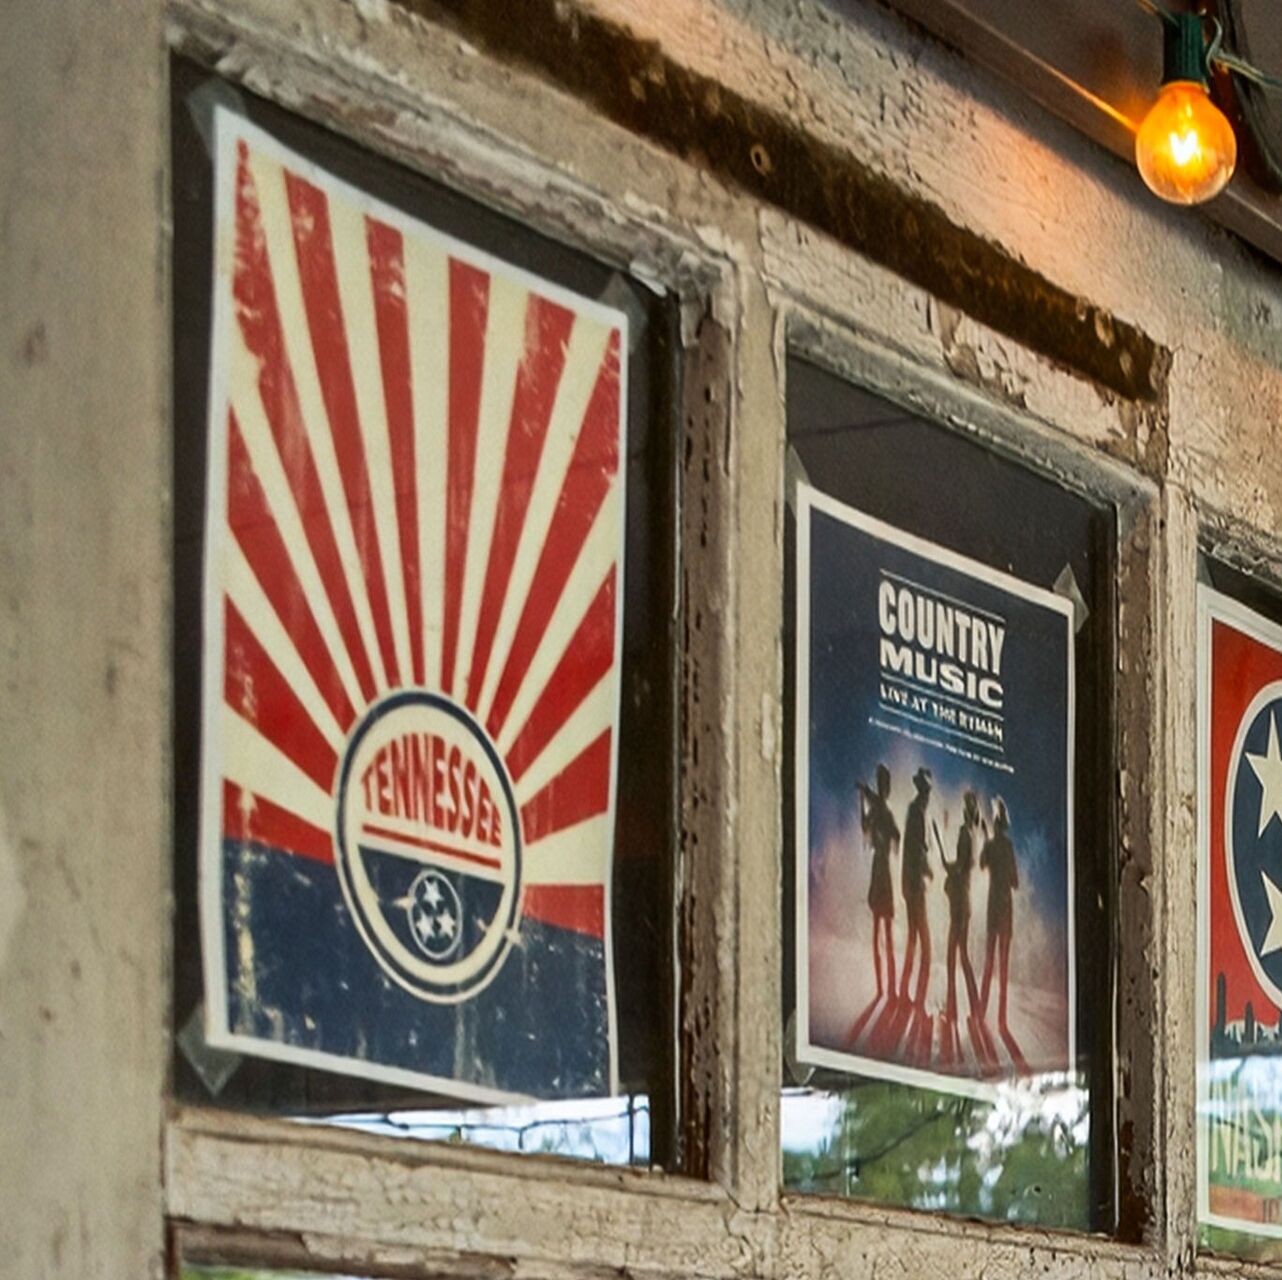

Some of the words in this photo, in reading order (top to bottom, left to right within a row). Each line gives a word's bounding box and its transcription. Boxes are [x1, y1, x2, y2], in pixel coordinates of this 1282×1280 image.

[878, 580, 1005, 674] COUNTRY
[879, 638, 1005, 708] MUSIC
[879, 683, 908, 707] LIVE
[911, 695, 929, 713] AT
[361, 732, 503, 847] TENNESSEE
